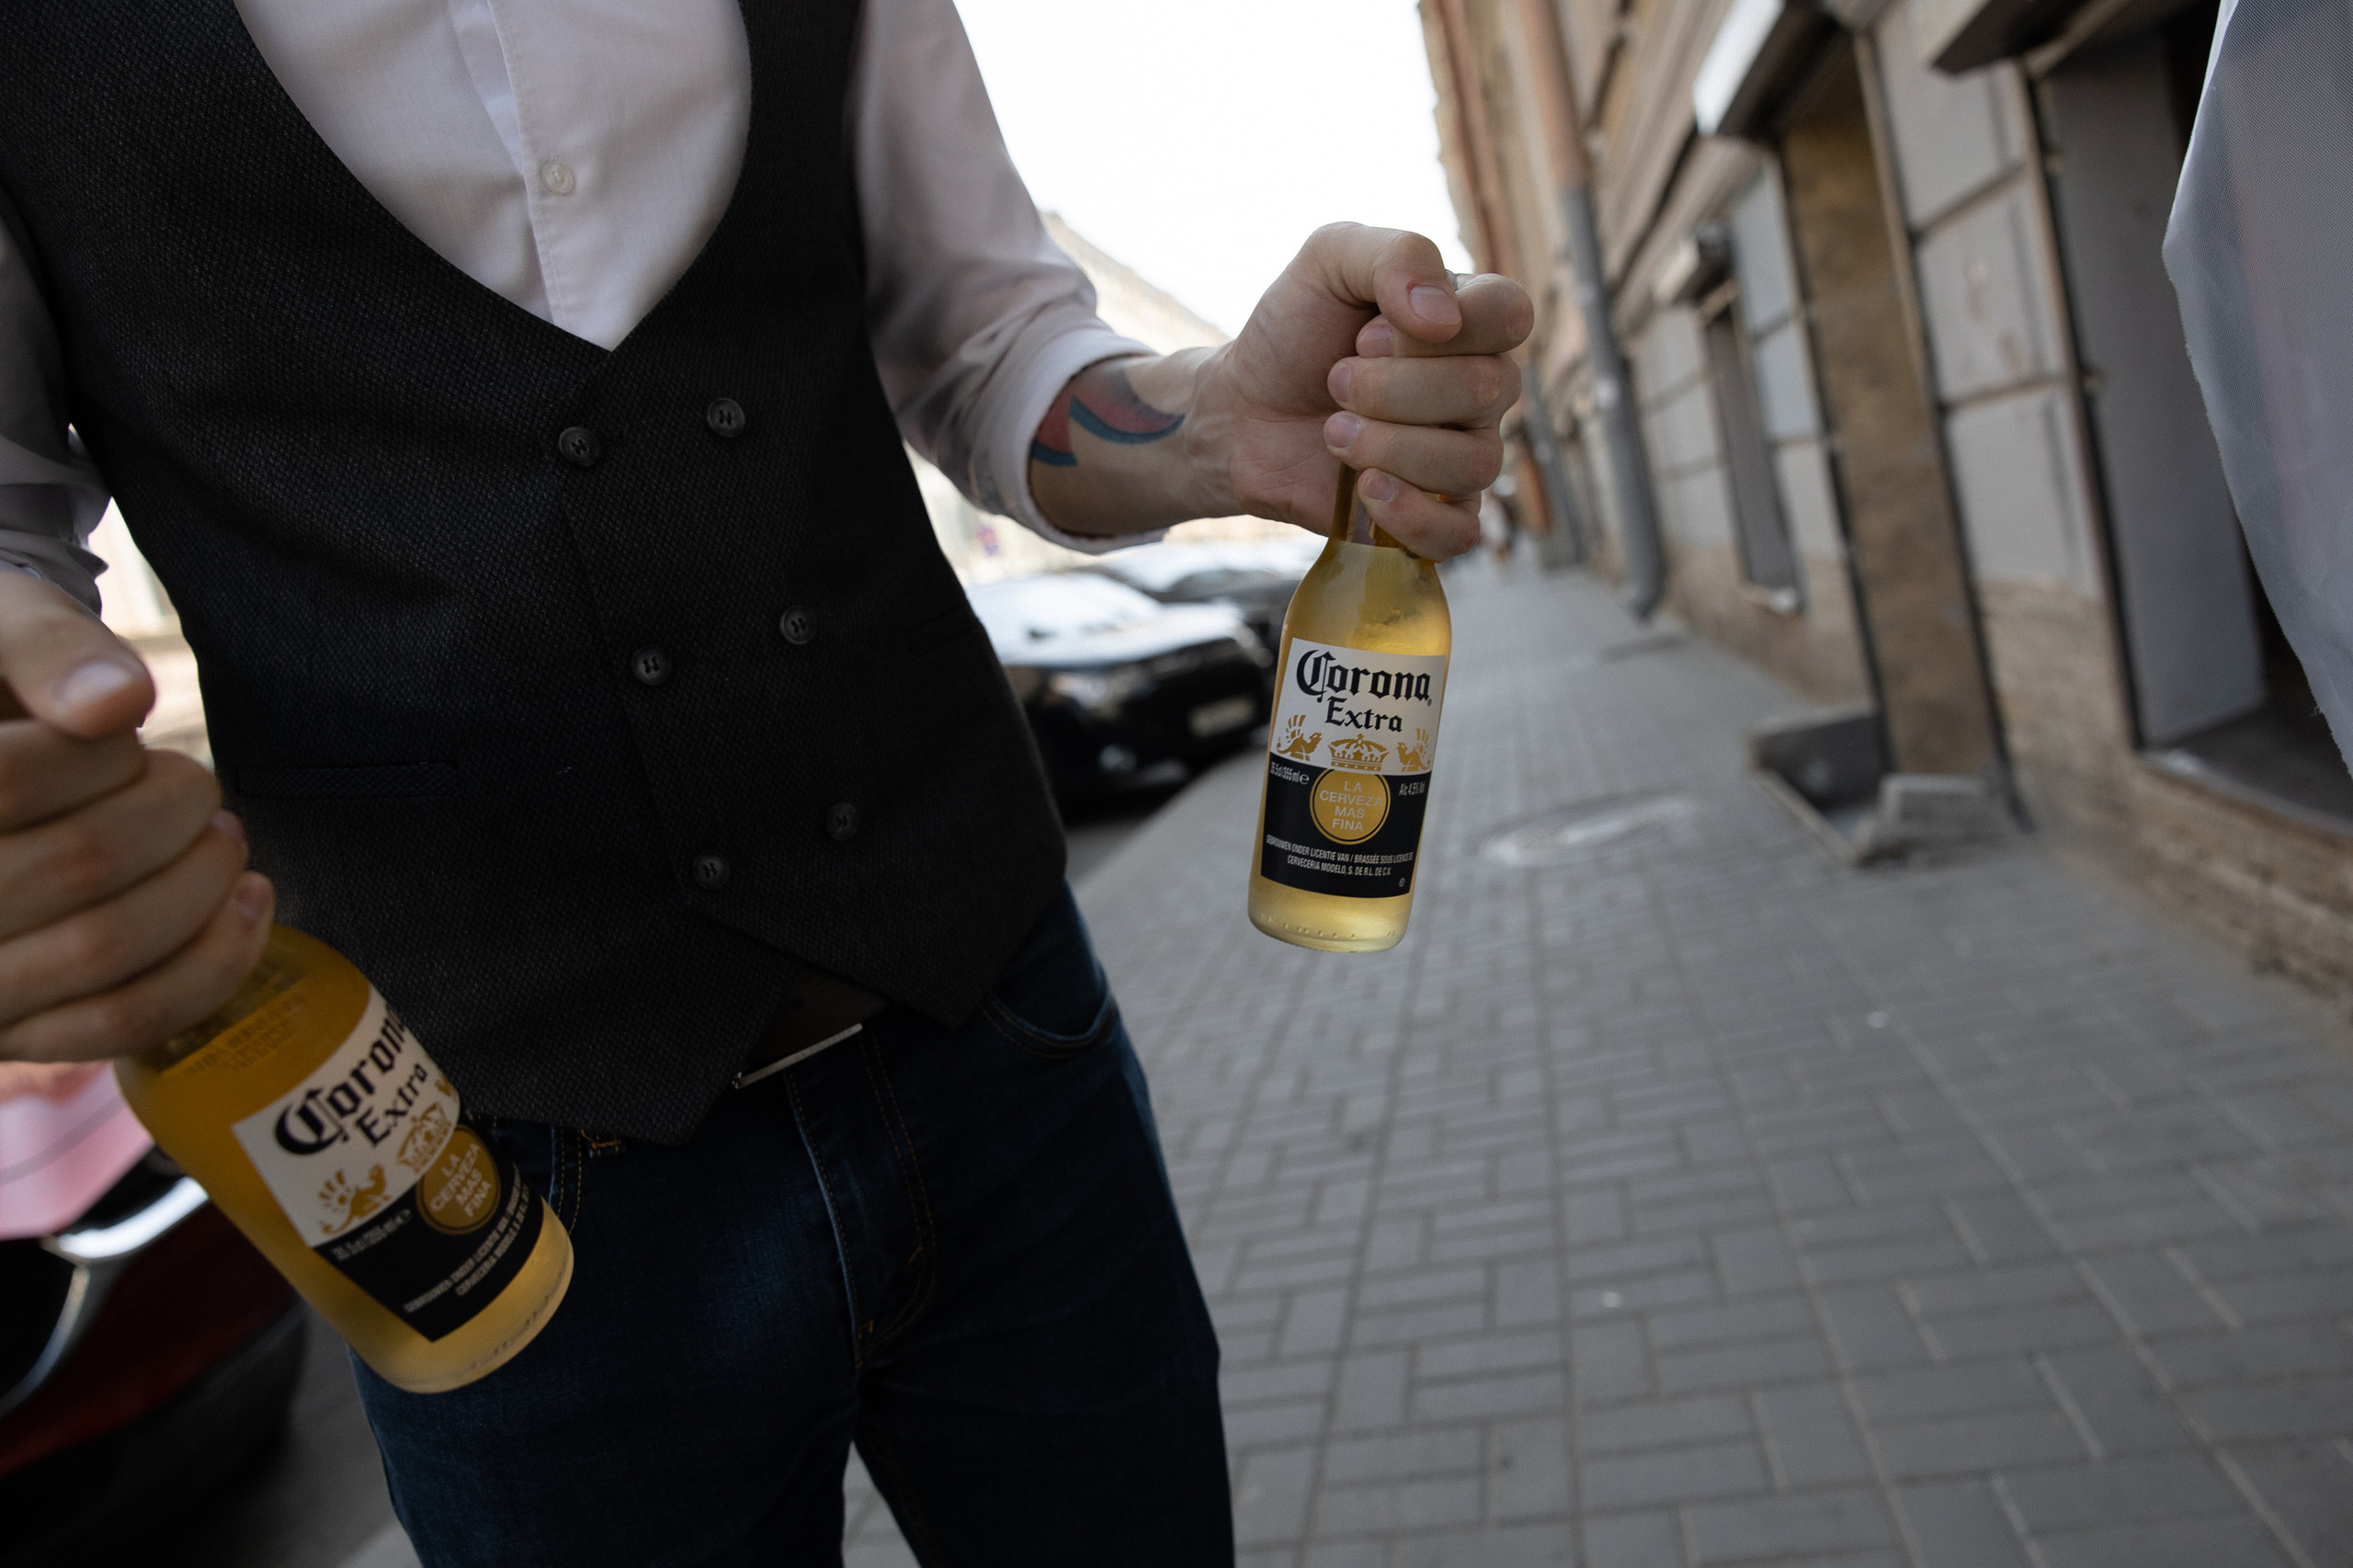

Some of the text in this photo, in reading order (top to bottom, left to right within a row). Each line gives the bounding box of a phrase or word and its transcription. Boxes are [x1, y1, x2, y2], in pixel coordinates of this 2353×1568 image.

[1296, 649, 1431, 703] Corona
[1324, 696, 1403, 733] Extra
[1344, 780, 1362, 792] LA
[1320, 790, 1383, 807] CERVEZA
[1335, 805, 1365, 819] MAS
[1332, 818, 1364, 832] FINA
[1287, 854, 1321, 870] CERVECERIA
[1291, 843, 1311, 856] ONDER
[1310, 847, 1336, 861] LICENTIE
[1336, 851, 1350, 862] VAN
[355, 1062, 430, 1148] Extra
[430, 1142, 480, 1212] CERVEZA
[440, 1153, 461, 1177] LA
[455, 1168, 483, 1206] MAS
[464, 1180, 493, 1218] FINA
